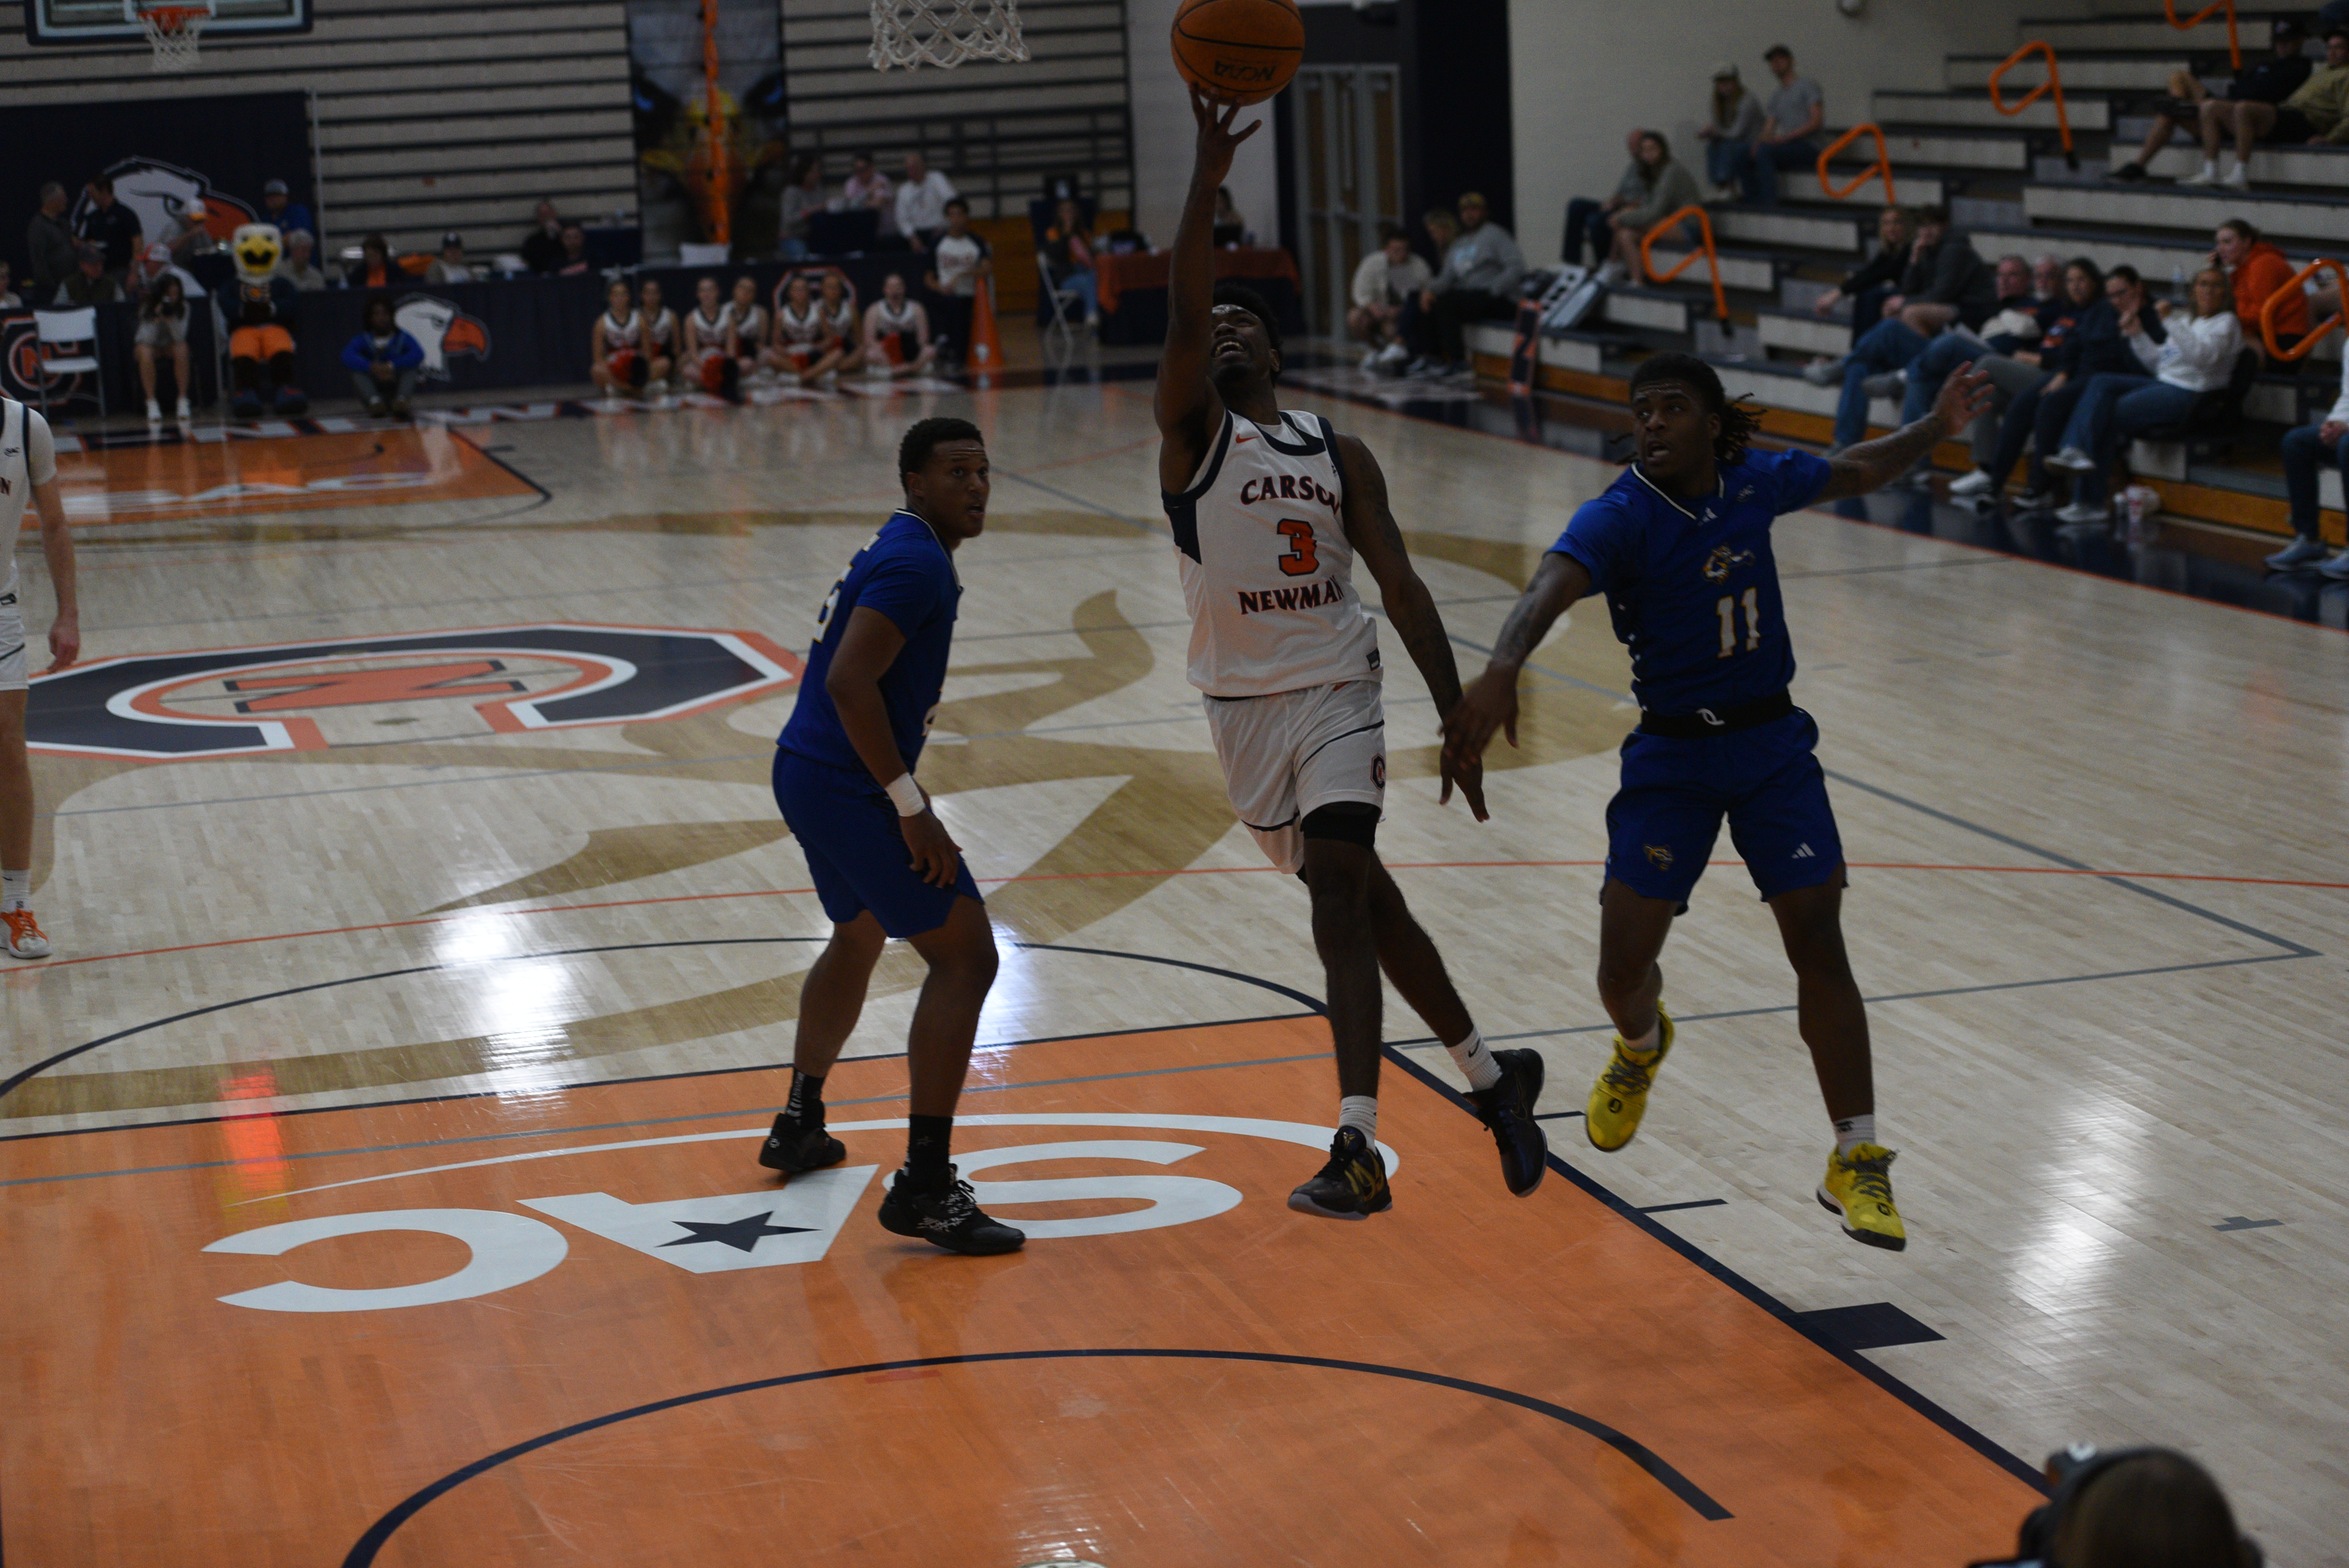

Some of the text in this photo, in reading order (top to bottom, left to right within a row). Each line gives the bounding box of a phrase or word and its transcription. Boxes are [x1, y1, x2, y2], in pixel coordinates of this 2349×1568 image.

[1213, 60, 1279, 81] NCAA
[1277, 517, 1320, 577] 3
[1716, 586, 1761, 660] 11
